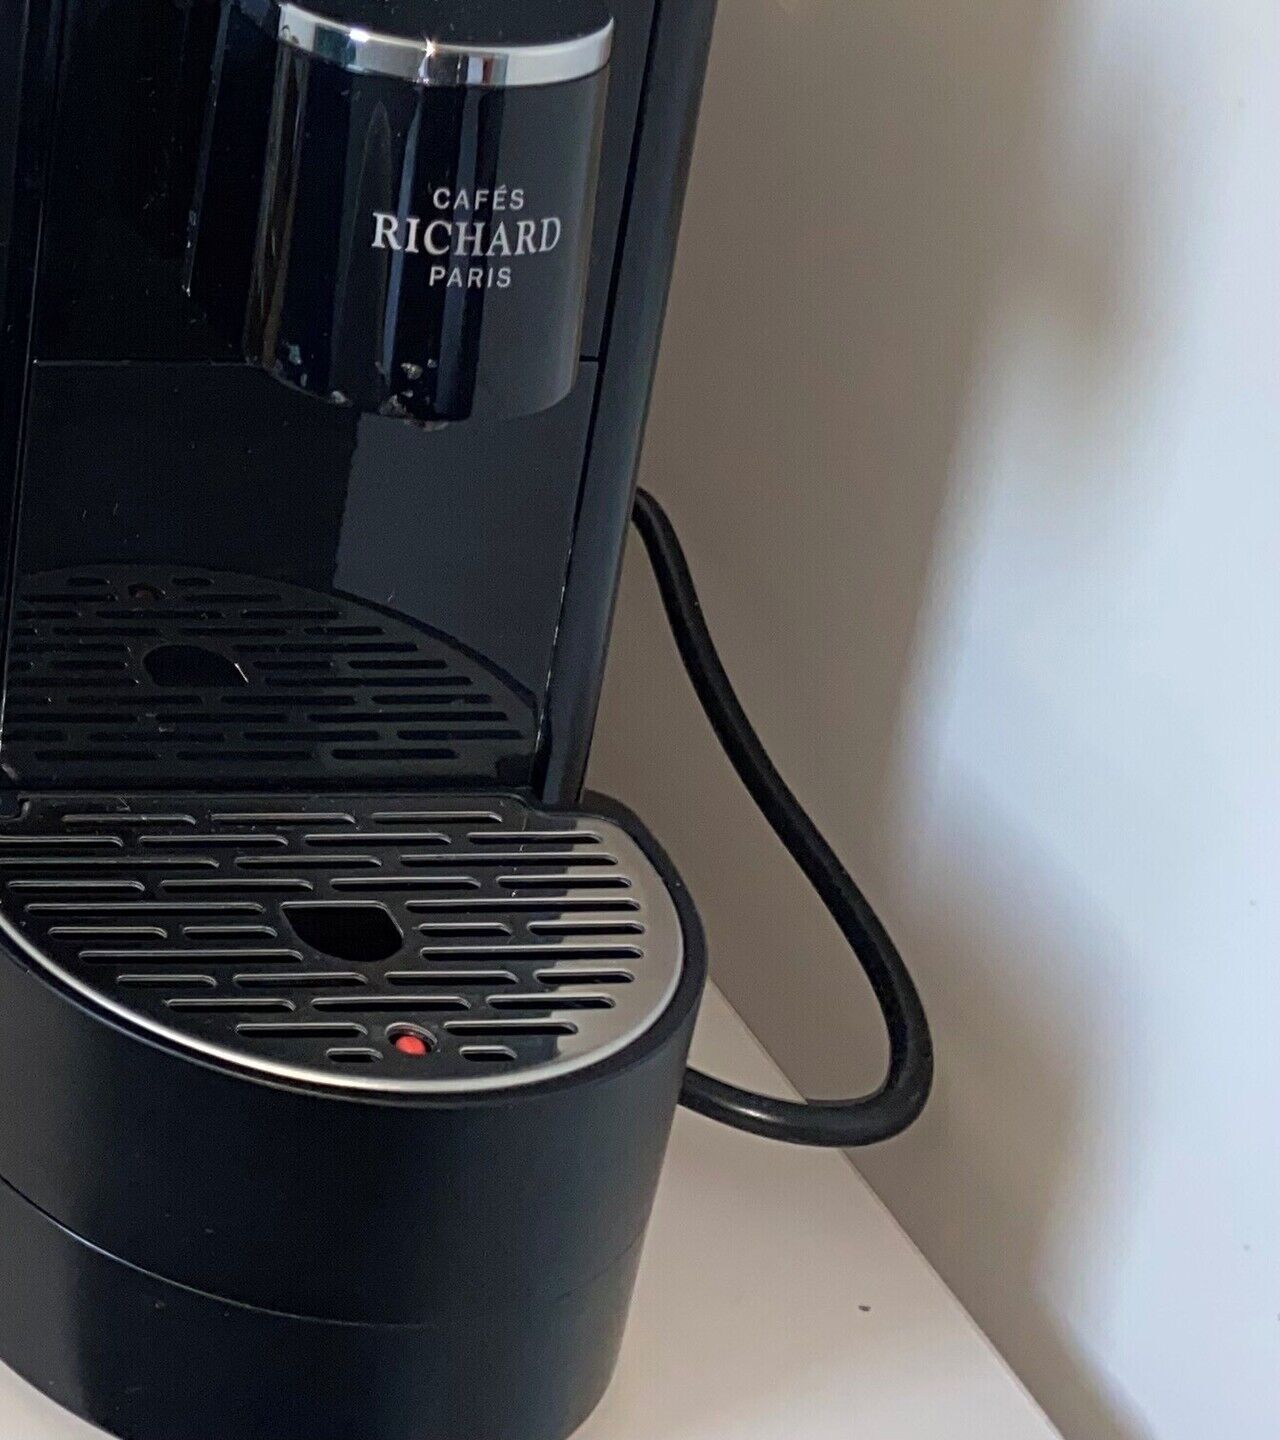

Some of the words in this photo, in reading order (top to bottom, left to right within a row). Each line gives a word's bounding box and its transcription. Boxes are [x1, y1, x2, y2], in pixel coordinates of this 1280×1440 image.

[432, 184, 525, 211] CAFÉS
[371, 211, 562, 257] RICHARD
[428, 266, 513, 290] PARIS
